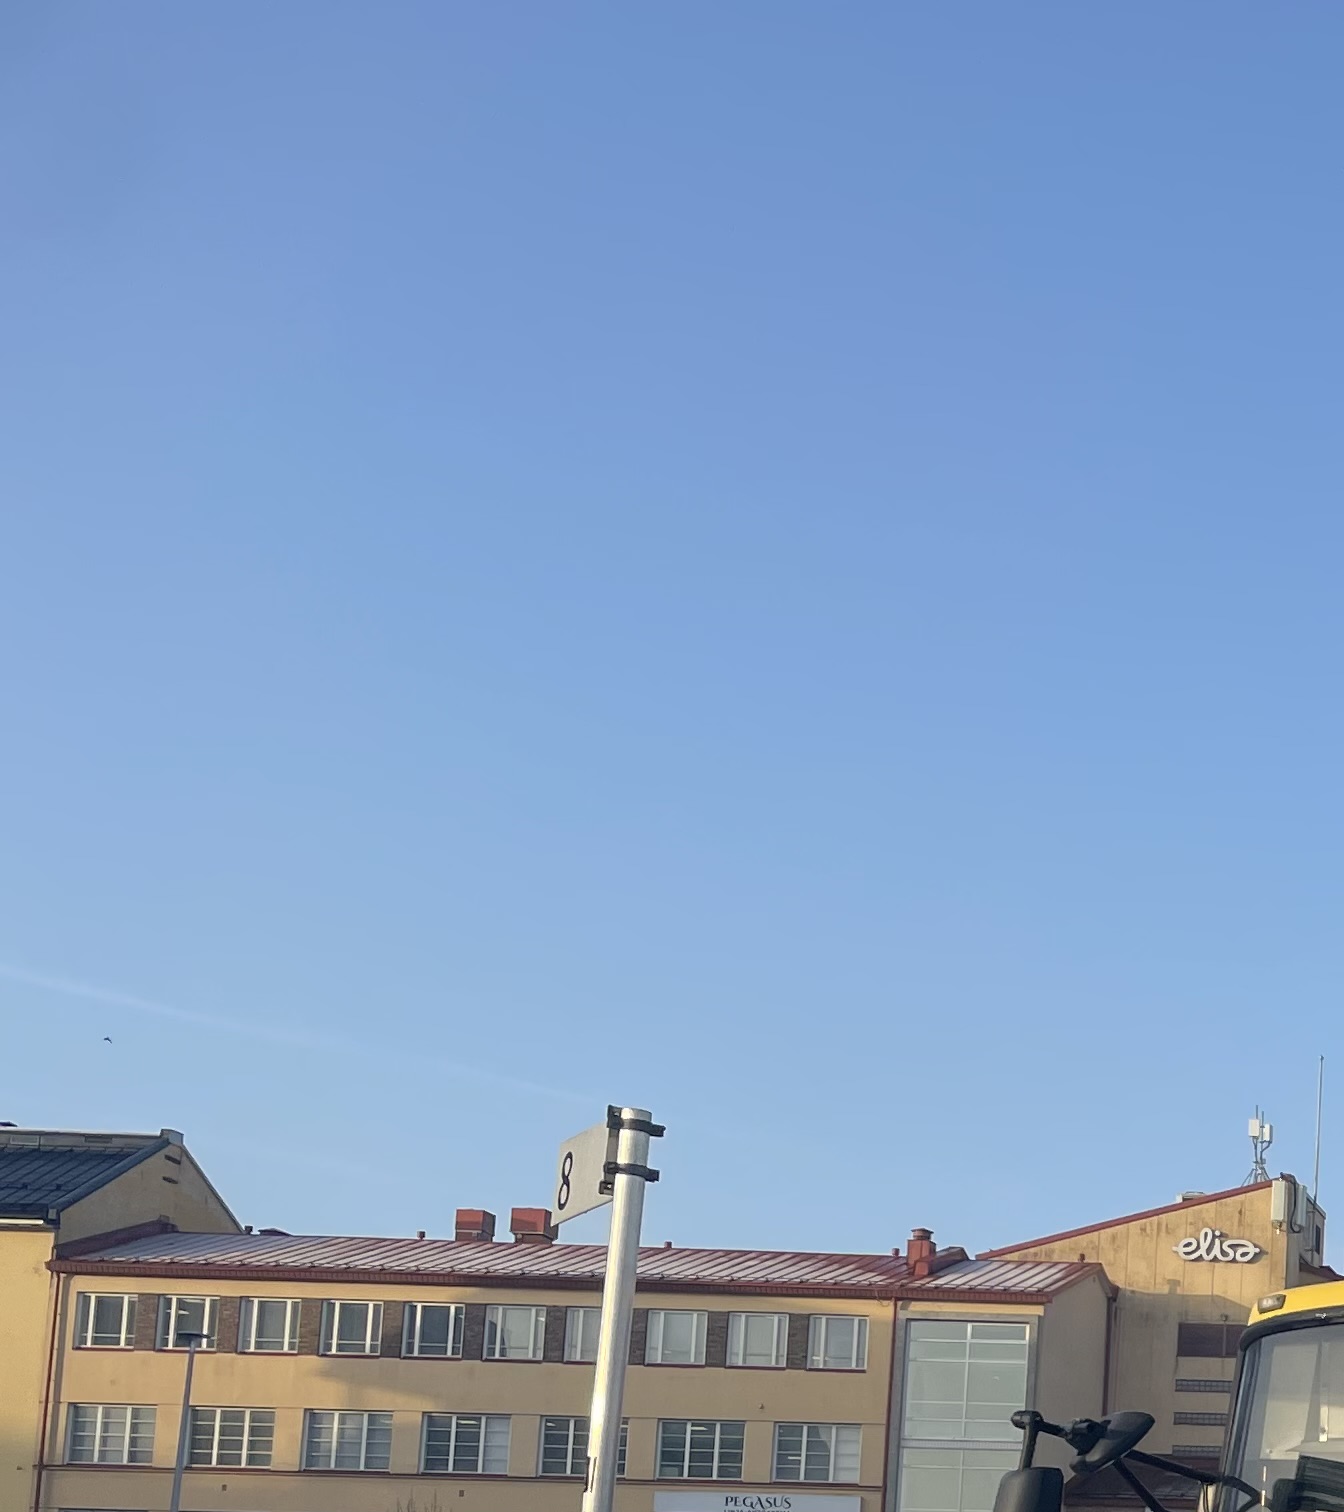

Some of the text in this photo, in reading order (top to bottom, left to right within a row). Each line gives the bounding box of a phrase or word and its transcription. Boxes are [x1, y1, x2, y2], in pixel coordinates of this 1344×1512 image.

[558, 1151, 573, 1211] 8
[1172, 1227, 1260, 1262] elisa
[724, 1496, 792, 1510] PEGASUS
